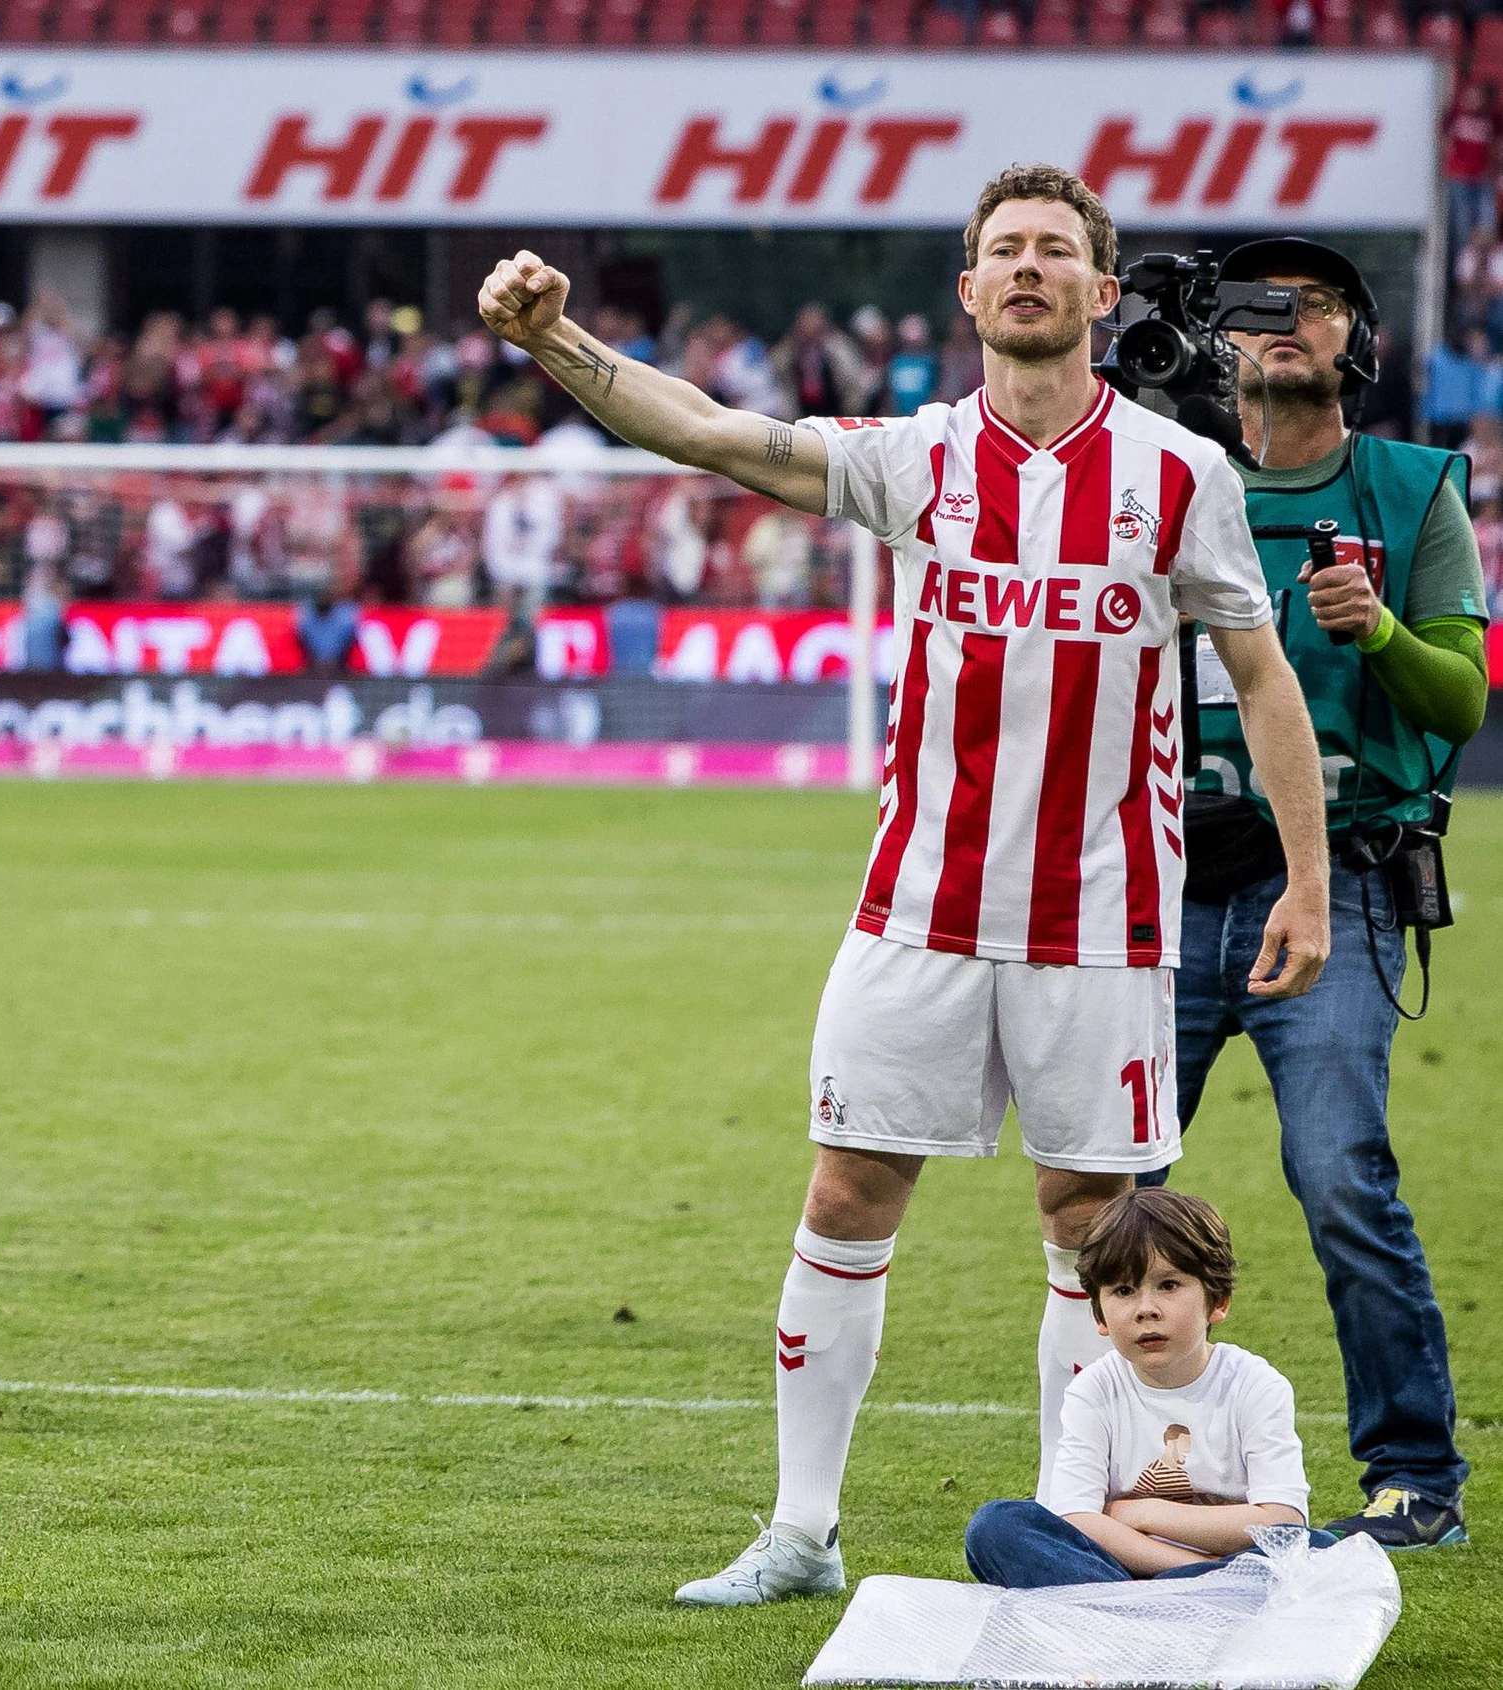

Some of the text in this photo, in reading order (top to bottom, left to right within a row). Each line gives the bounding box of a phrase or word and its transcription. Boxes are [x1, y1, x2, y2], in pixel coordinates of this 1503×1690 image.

[246, 114, 550, 201] HIT
[656, 116, 964, 204] HIT
[1081, 116, 1382, 206] HIT
[1266, 290, 1291, 298] SONY
[935, 510, 975, 525] hummel
[919, 560, 1081, 632] REWE
